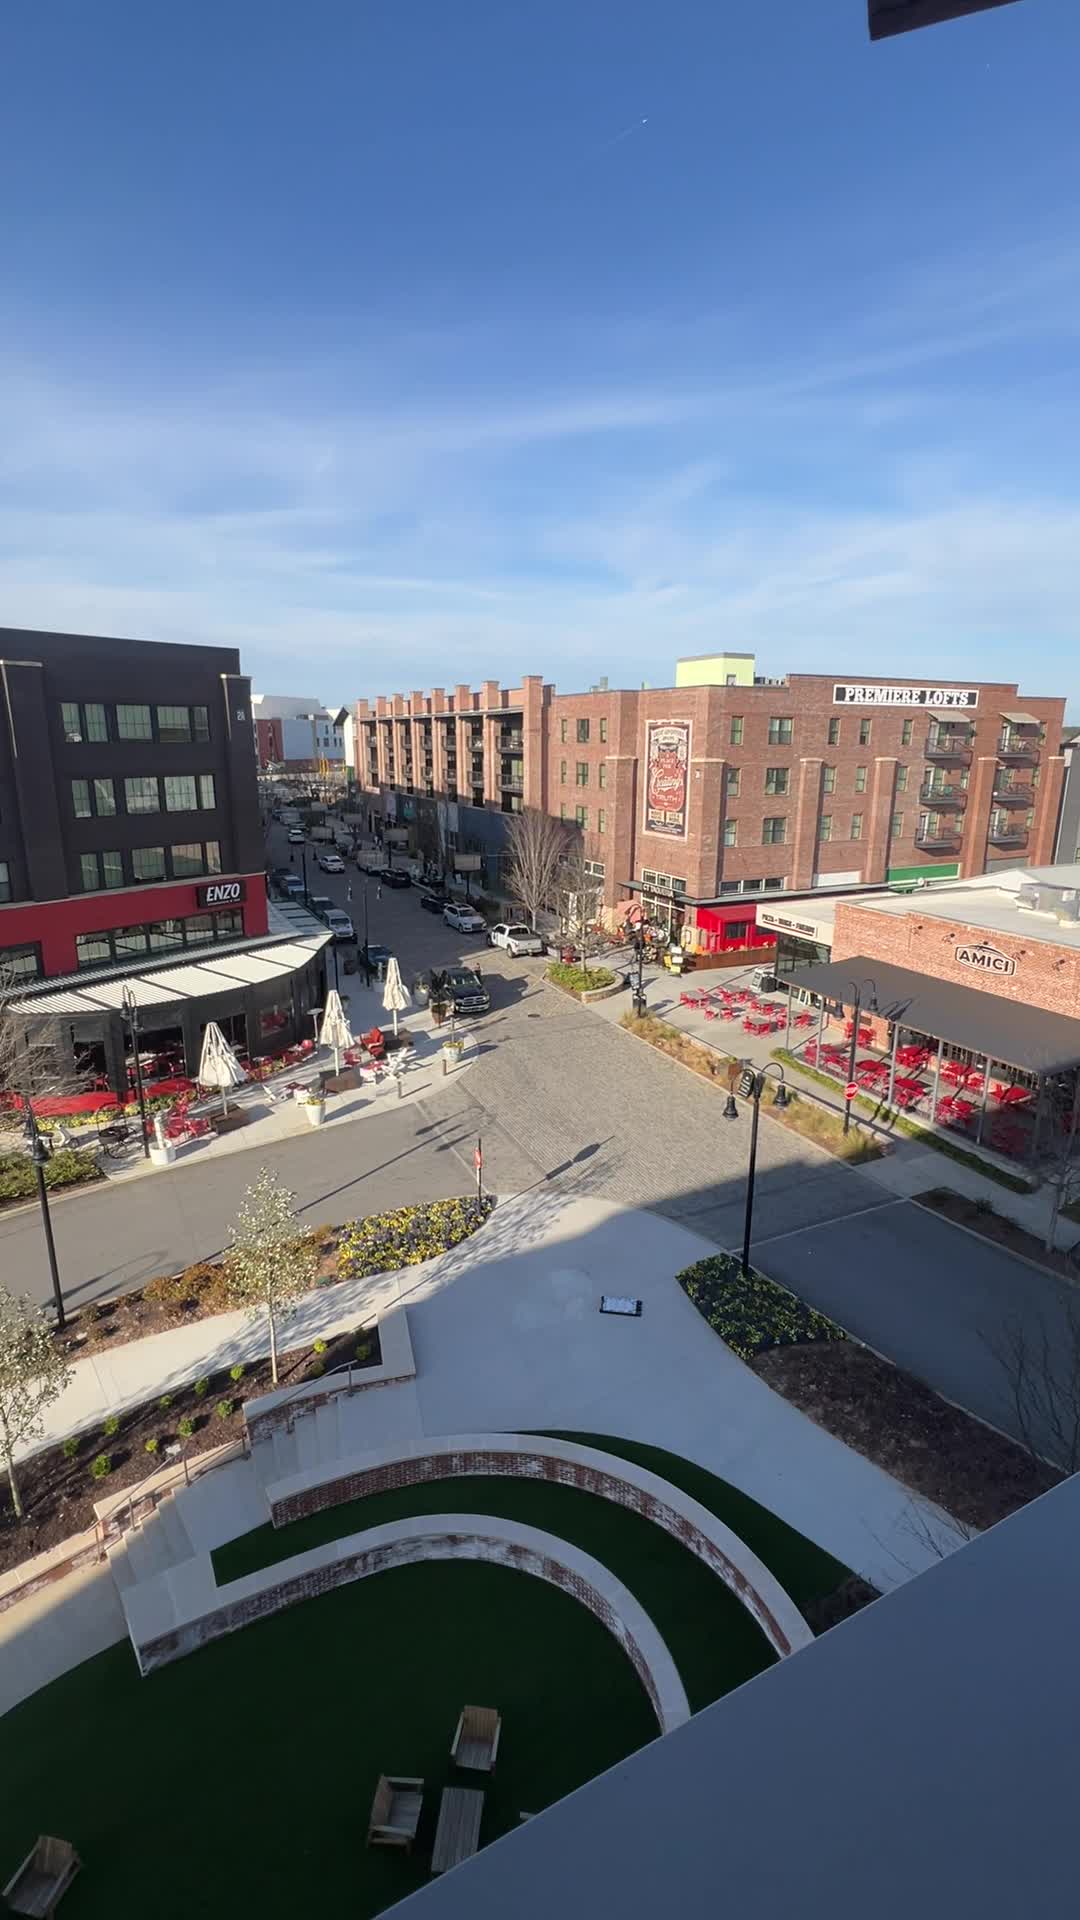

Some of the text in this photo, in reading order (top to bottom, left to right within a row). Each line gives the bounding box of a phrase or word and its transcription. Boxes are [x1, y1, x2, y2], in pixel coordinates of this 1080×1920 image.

[844, 687, 969, 705] PREMIERE LOFTS
[207, 883, 241, 902] ENZO
[959, 950, 1010, 972] AMICI
